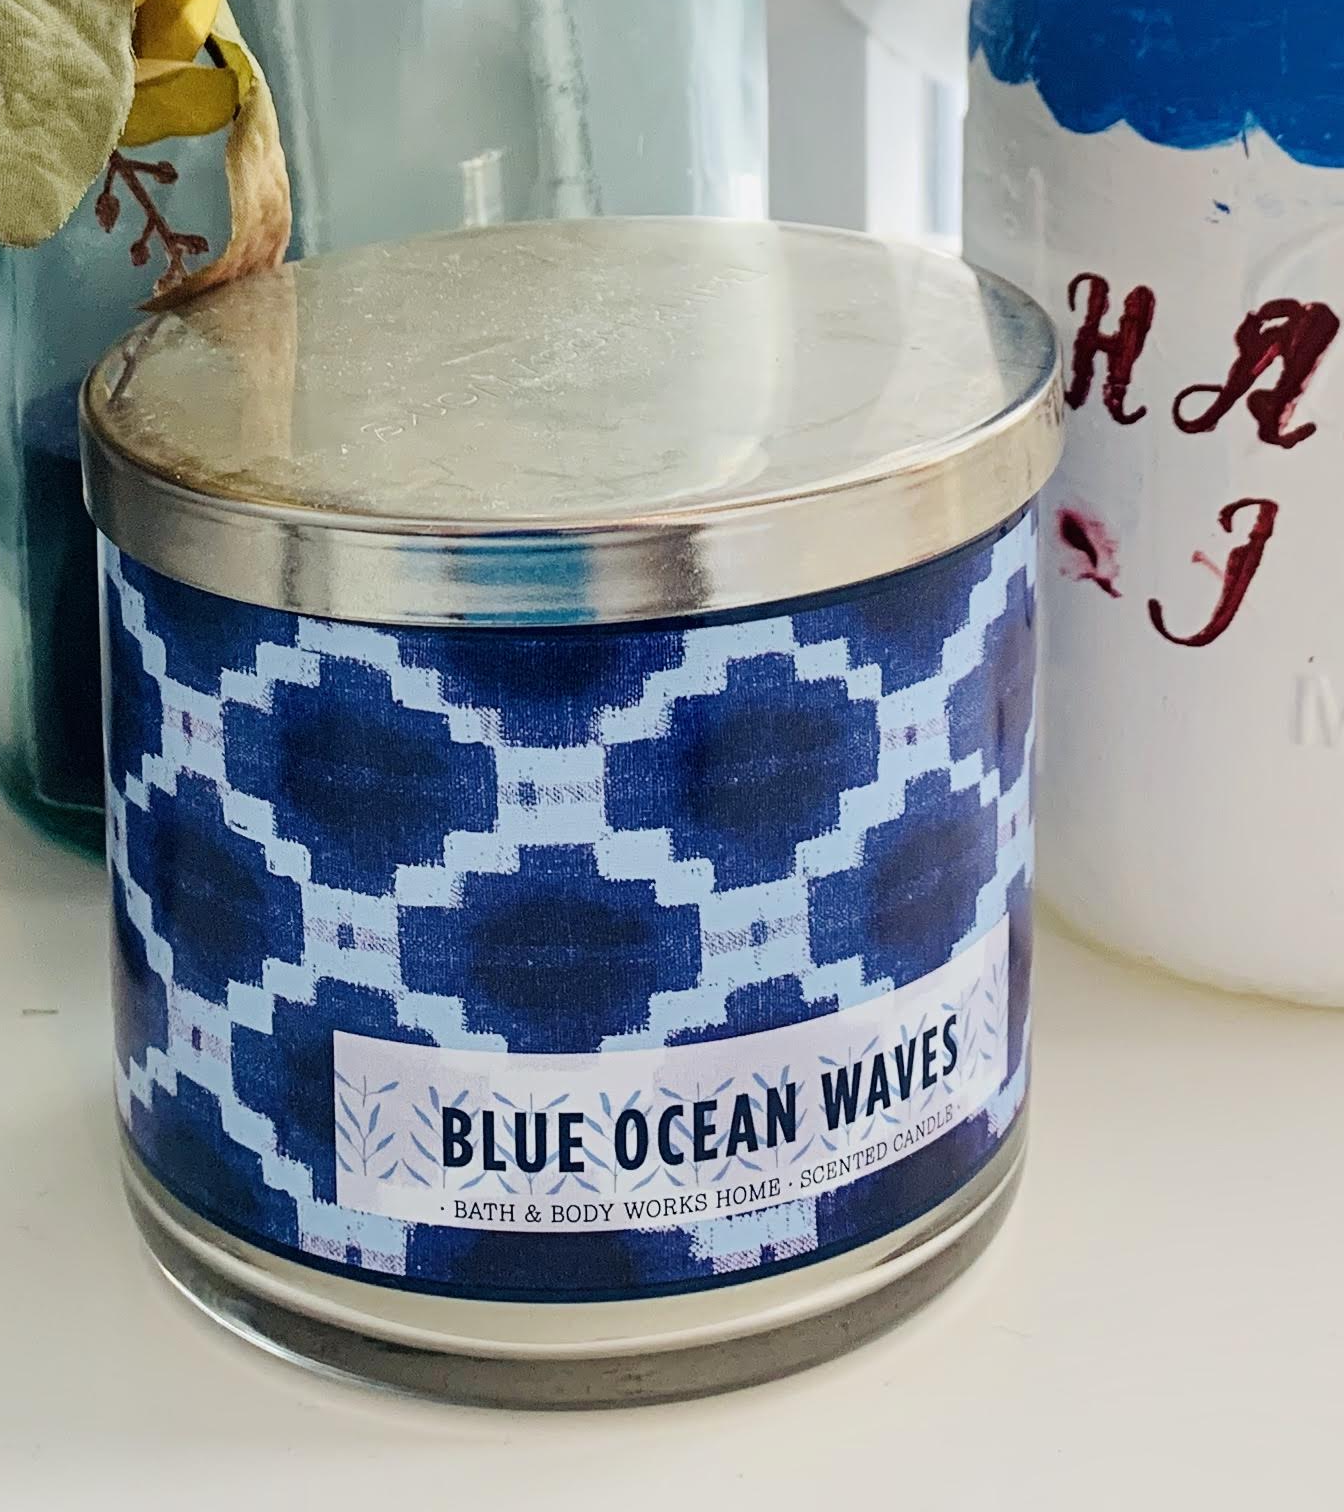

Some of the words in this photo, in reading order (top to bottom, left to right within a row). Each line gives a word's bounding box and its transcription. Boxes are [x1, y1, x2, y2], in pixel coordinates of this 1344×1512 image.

[440, 1105, 586, 1175] BLUE
[614, 1082, 796, 1171] OCEAN
[821, 1014, 959, 1131] WAVES
[453, 1199, 516, 1224] BATH
[523, 1204, 543, 1224] &
[550, 1203, 616, 1224] BODY
[622, 1192, 709, 1222] WORKS
[716, 1178, 781, 1209] HOME
[800, 1141, 888, 1189] SCENTED
[892, 1104, 954, 1153] CANDLE
